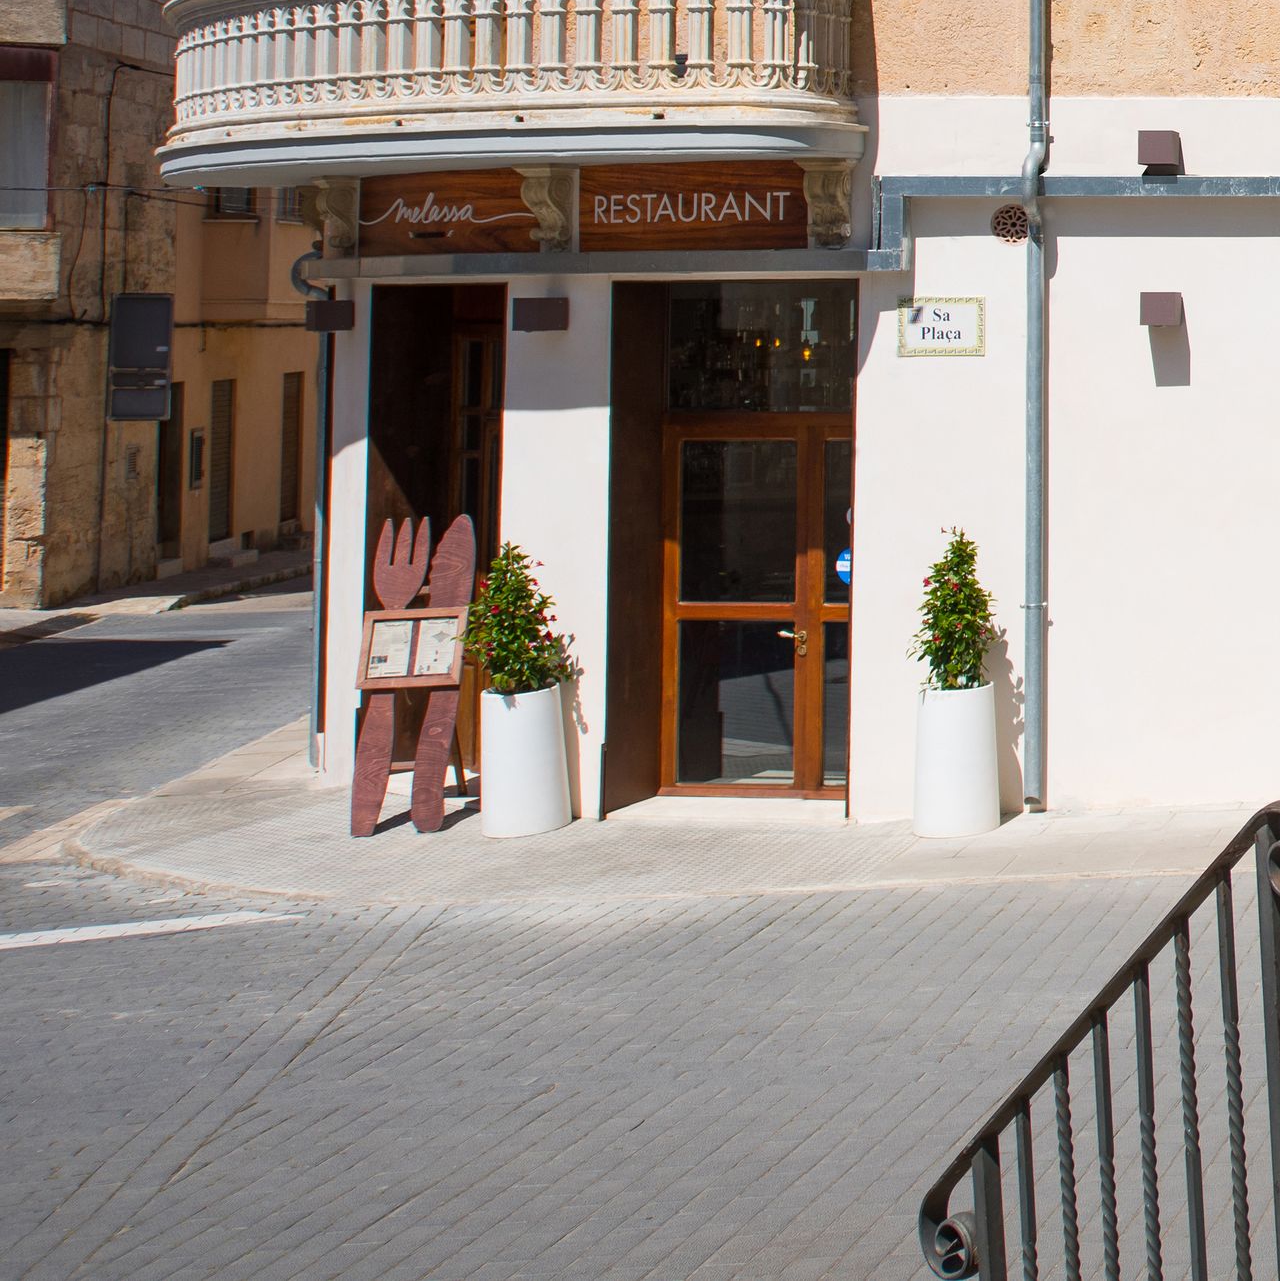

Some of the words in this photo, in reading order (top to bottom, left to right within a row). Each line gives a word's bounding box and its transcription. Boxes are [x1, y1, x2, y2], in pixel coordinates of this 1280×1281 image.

[594, 191, 791, 224] RESTAURANT
[933, 307, 951, 322] Sa
[921, 326, 962, 343] Plaça
